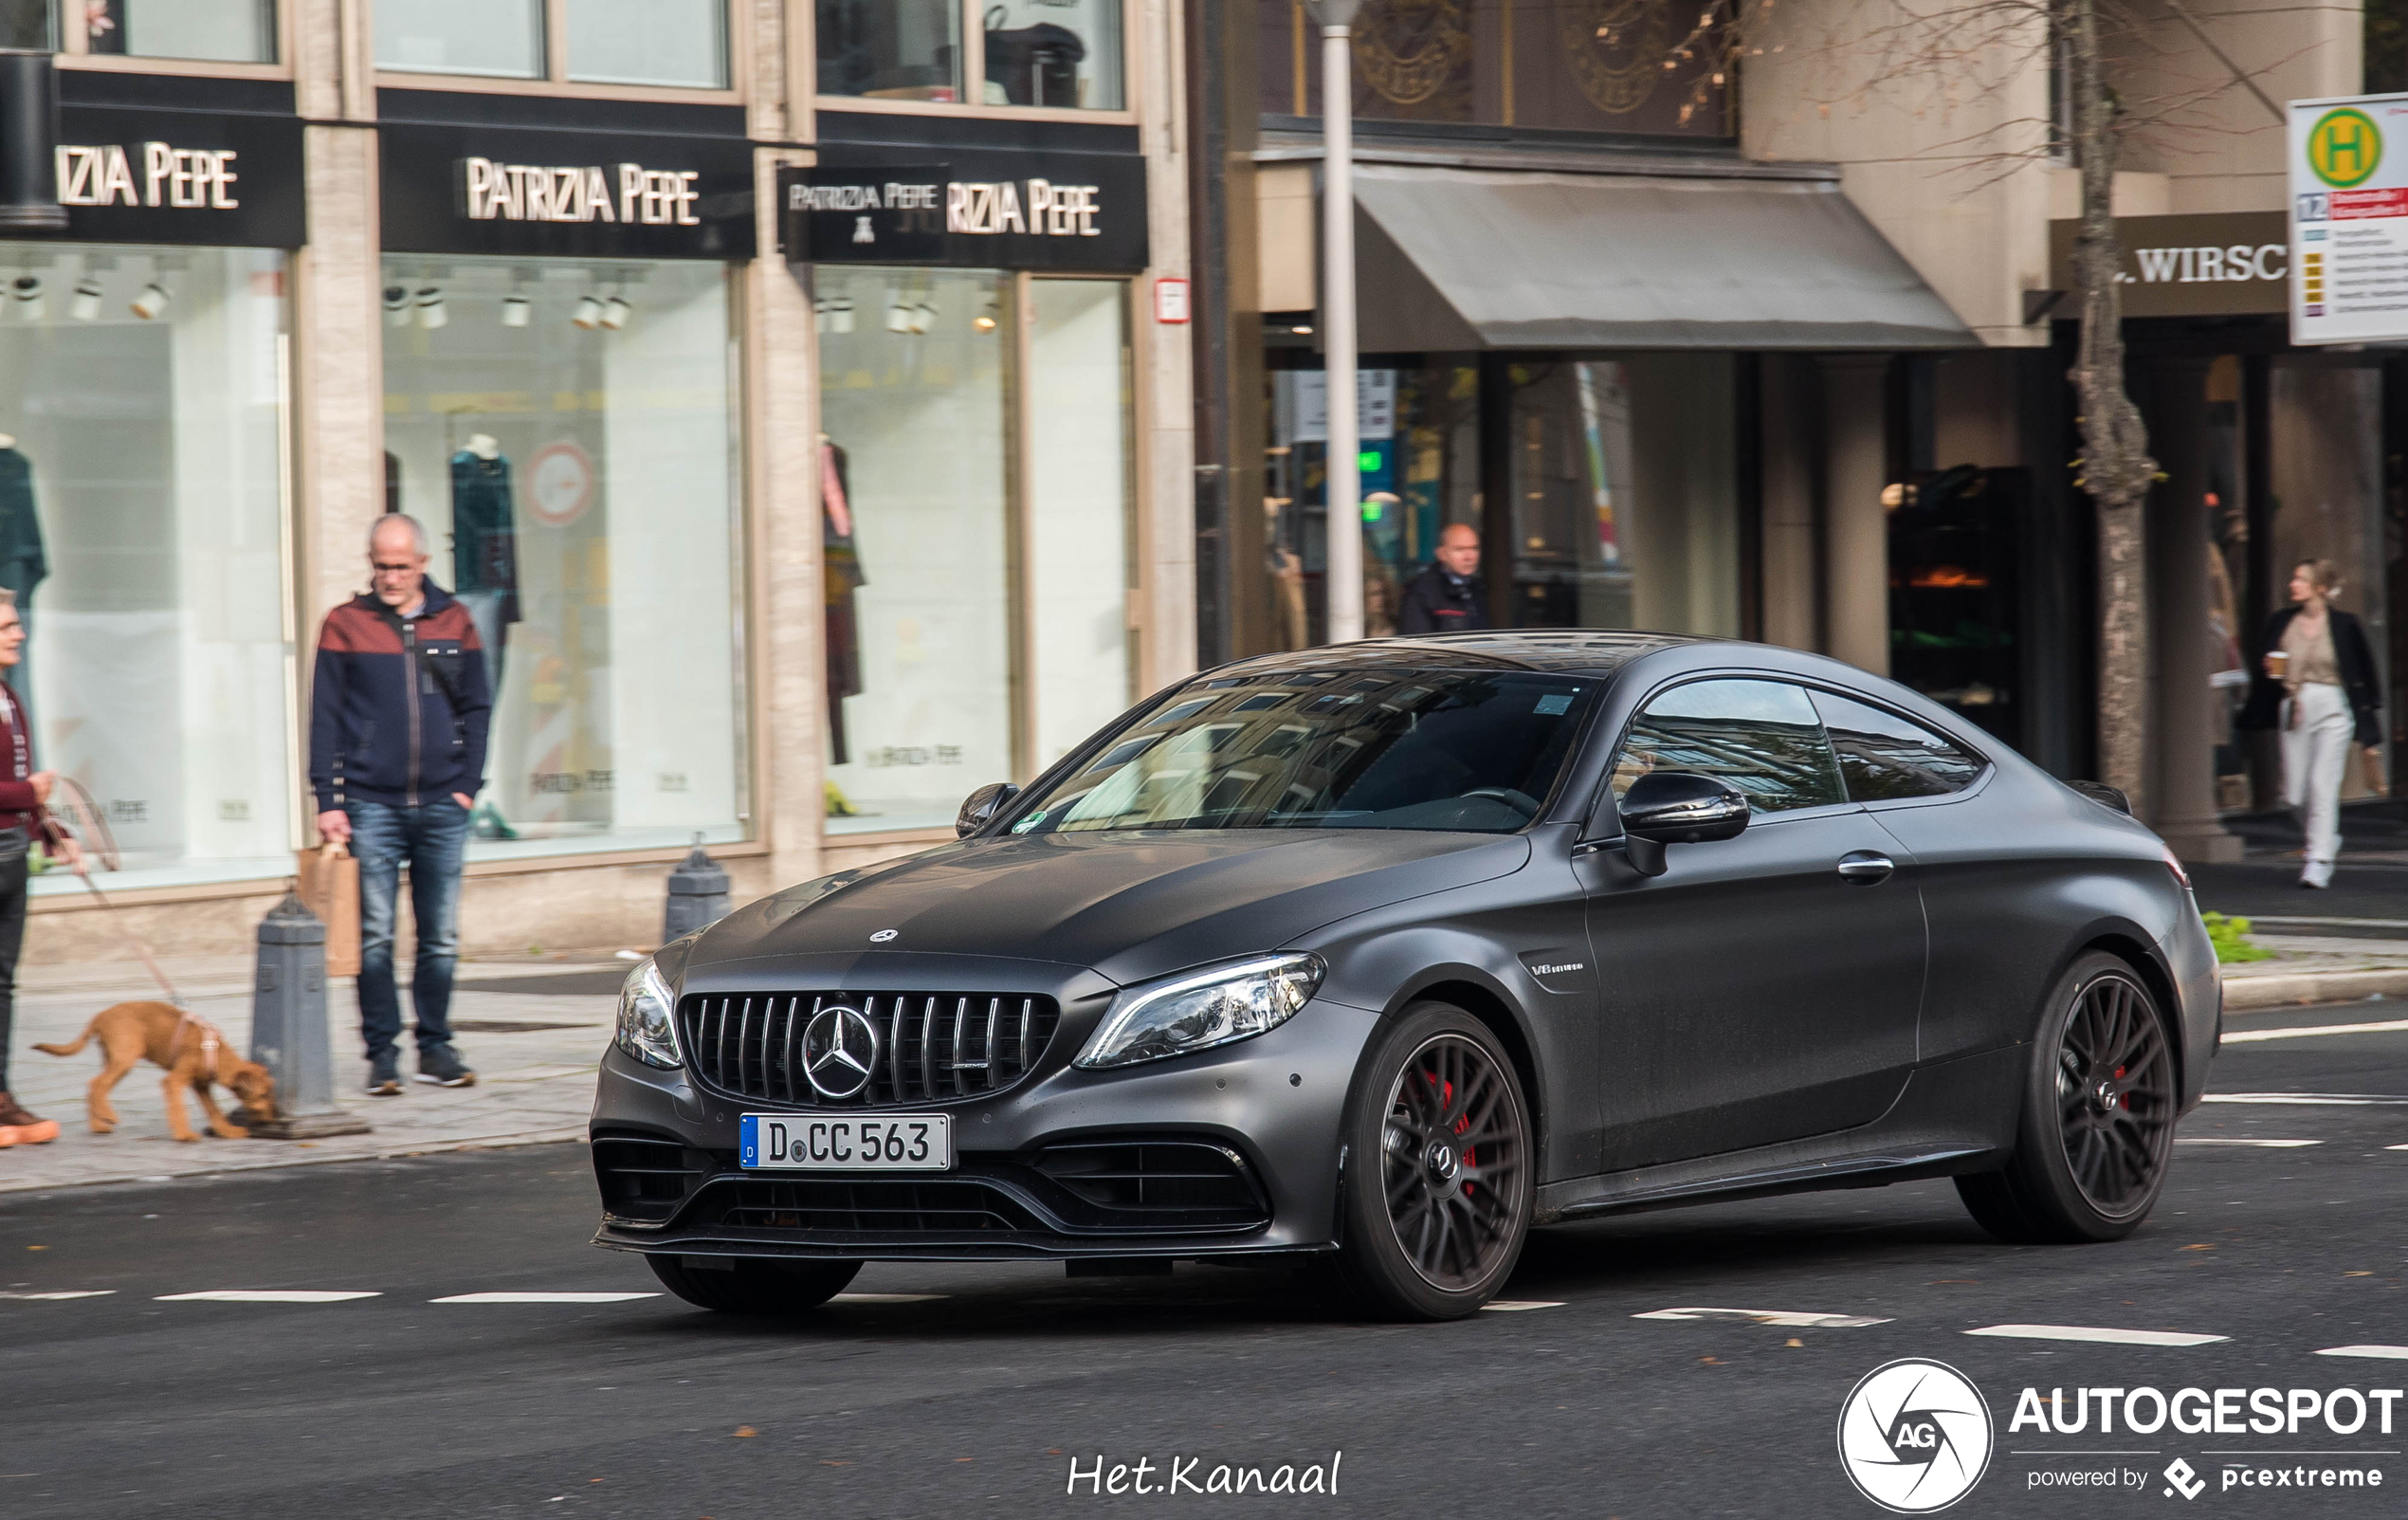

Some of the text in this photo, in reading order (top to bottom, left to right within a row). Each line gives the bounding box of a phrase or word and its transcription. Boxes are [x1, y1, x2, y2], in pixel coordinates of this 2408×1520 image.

[2326, 124, 2362, 172] H
[55, 141, 239, 209] IZIA PEPE
[466, 156, 701, 225] PATRIZIA PEPE
[789, 182, 939, 211] PATRIZIA PEPE
[947, 178, 1101, 236] RIZIA PEPE
[1531, 963, 1551, 976] V8
[746, 1146, 754, 1158] D
[769, 1123, 929, 1162] D CC 563
